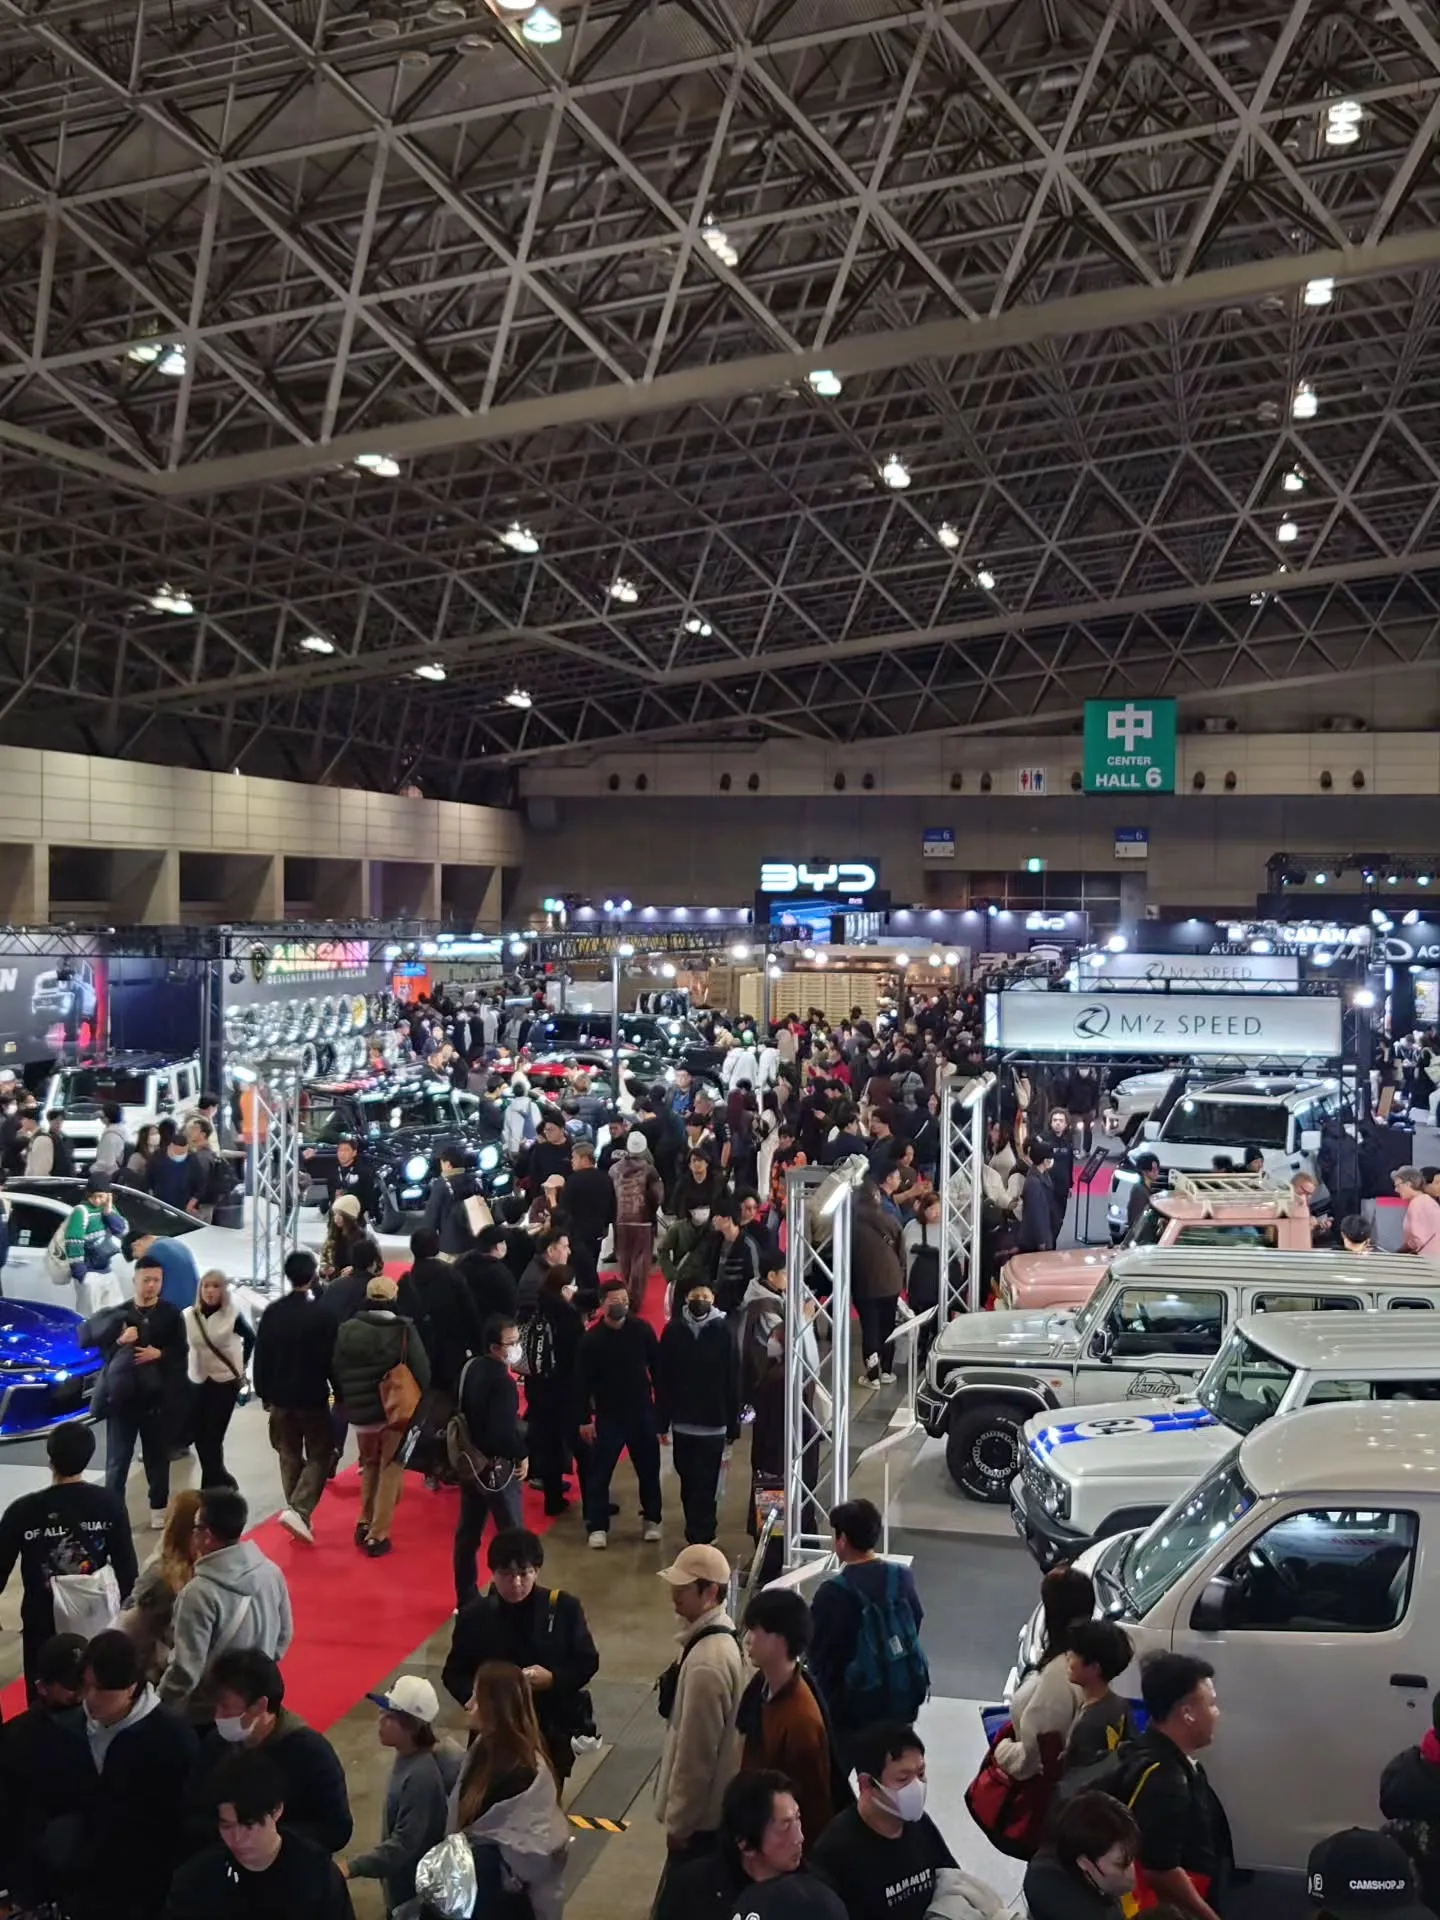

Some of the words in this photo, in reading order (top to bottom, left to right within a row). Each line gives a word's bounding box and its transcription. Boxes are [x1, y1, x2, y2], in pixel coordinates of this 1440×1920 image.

[1107, 703, 1153, 752] 中
[1107, 755, 1152, 767] CENTER
[1095, 773, 1141, 788] HALL
[1145, 767, 1162, 788] 6
[761, 864, 876, 892] BYD
[1209, 942, 1308, 956] AUTOTIVE
[1120, 1013, 1166, 1034] M'z
[1177, 1014, 1262, 1036] SPEED
[885, 1867, 931, 1899] MAMMUT
